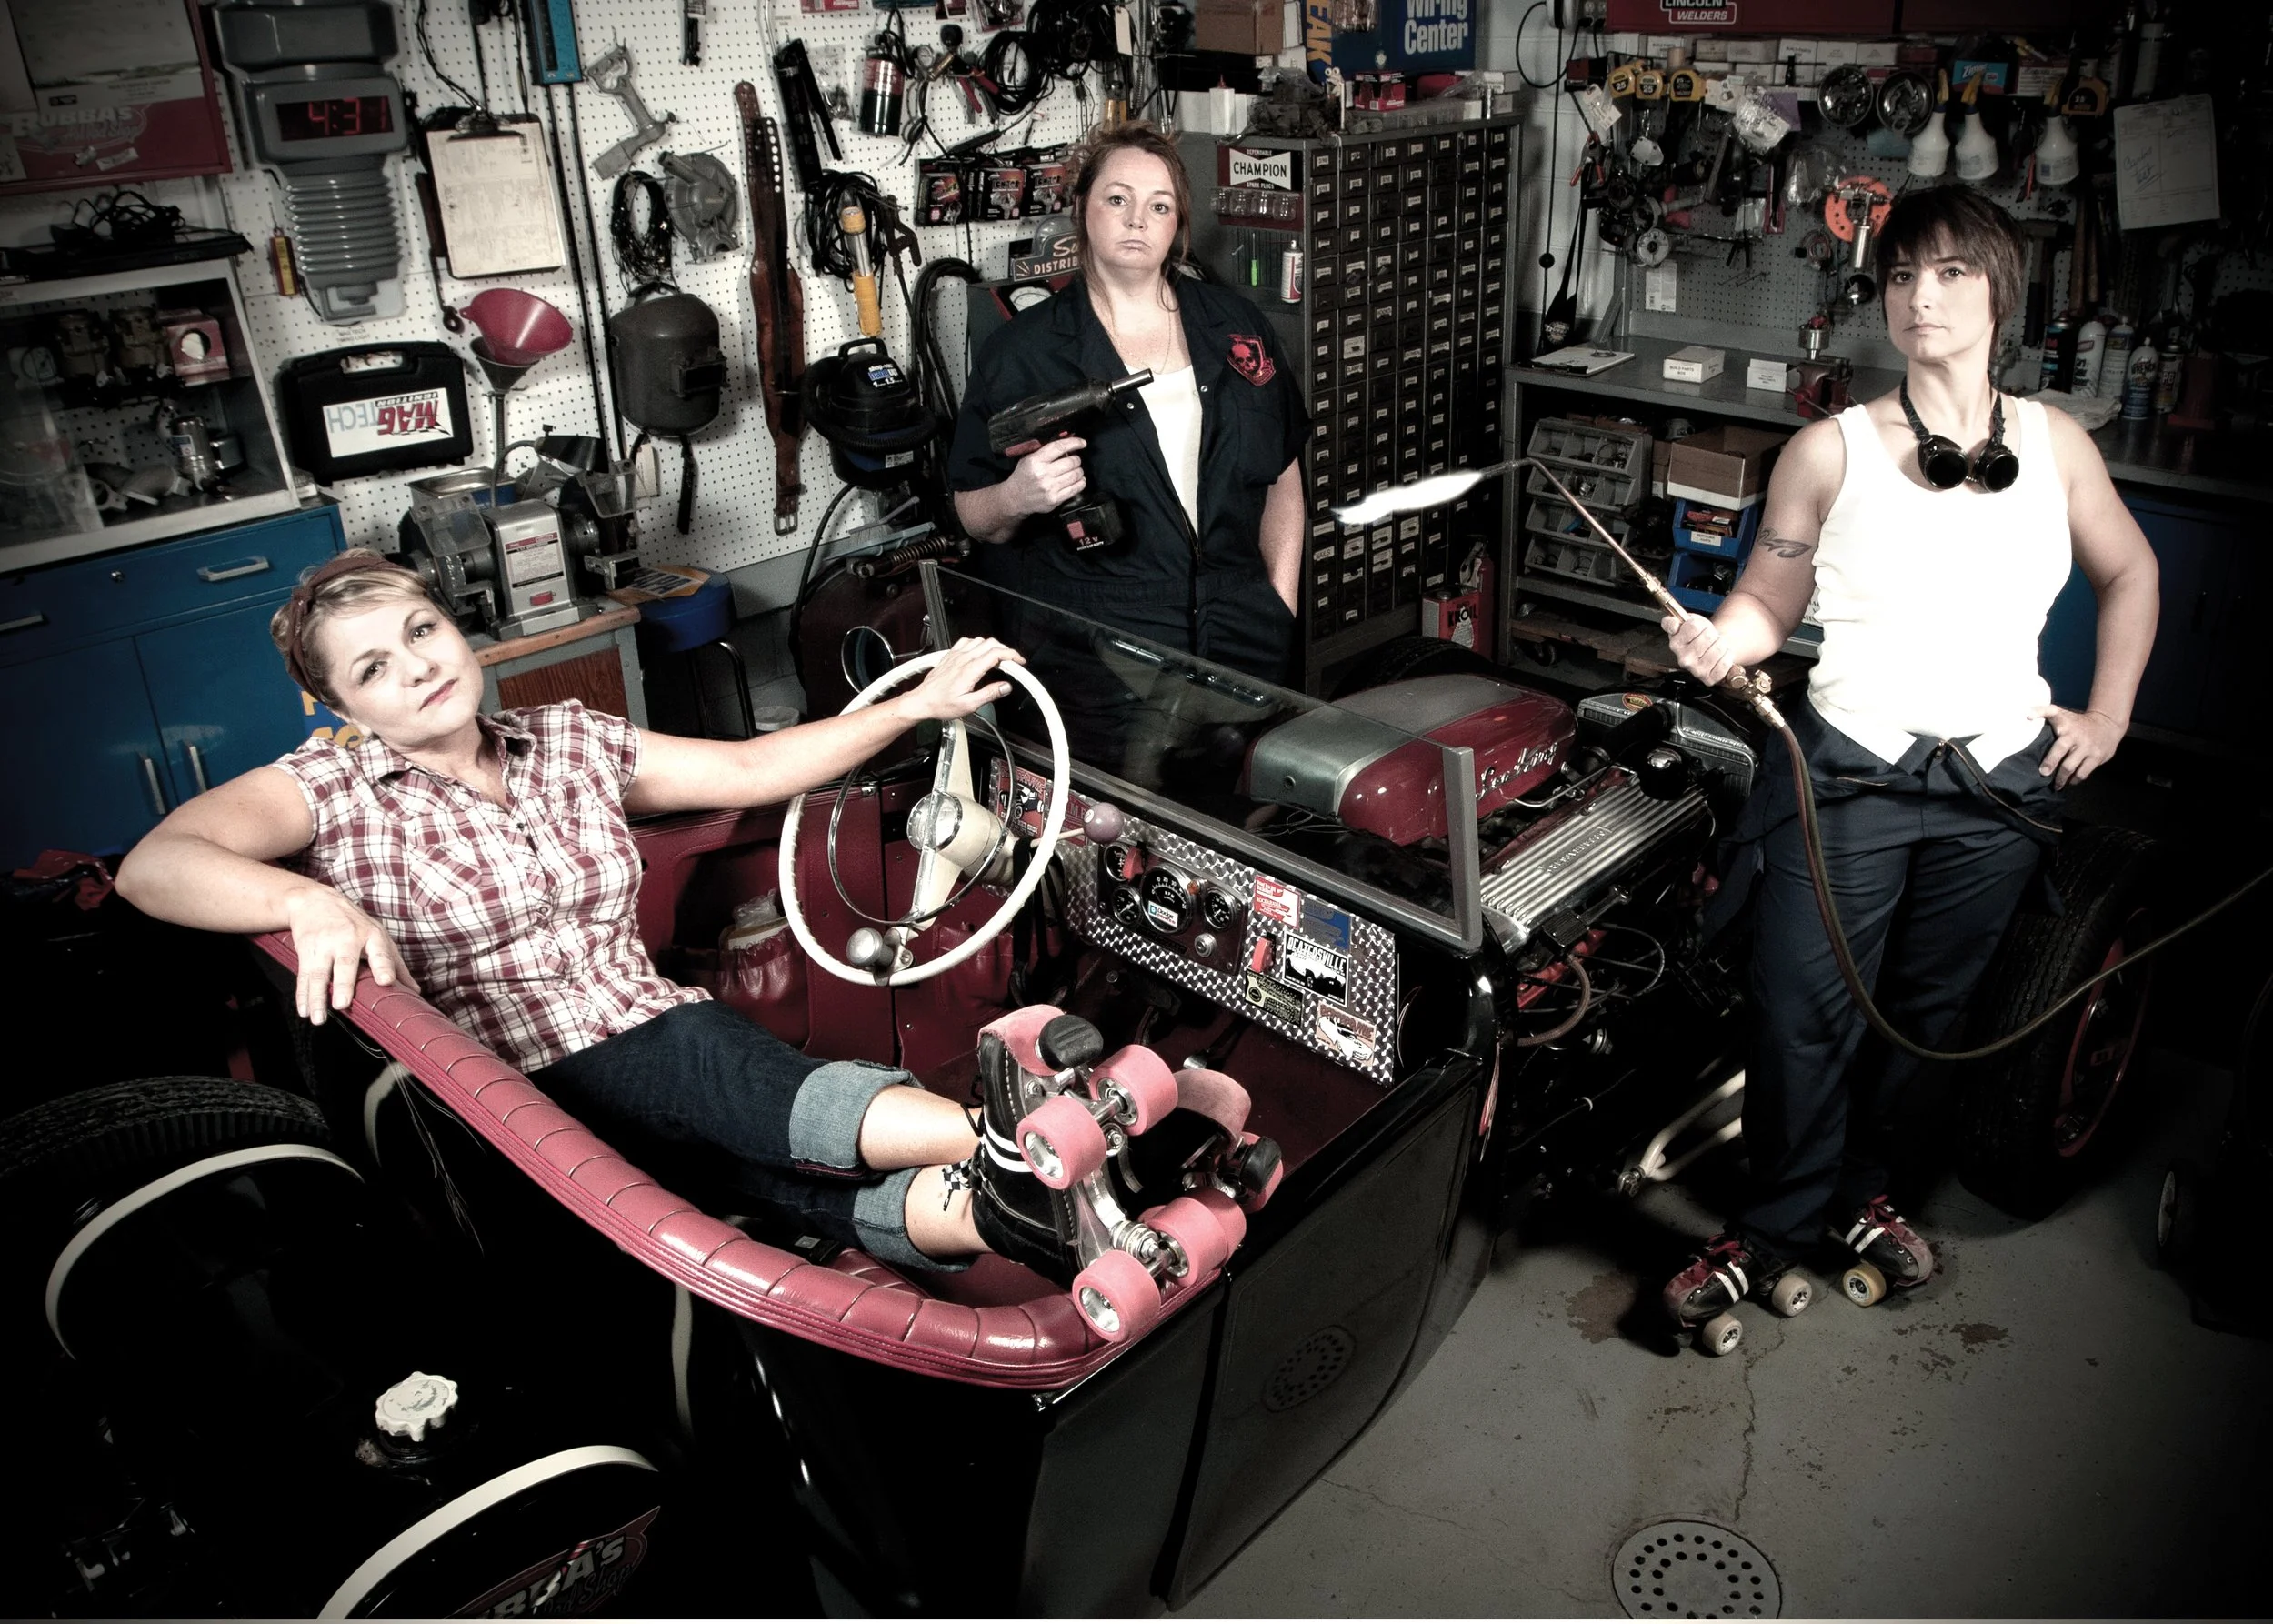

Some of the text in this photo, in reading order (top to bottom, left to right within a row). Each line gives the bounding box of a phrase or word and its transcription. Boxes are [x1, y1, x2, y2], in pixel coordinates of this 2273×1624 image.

[1677, 10, 1728, 21] WELDERS
[1404, 19, 1468, 55] Center
[1643, 85, 1654, 95] 25
[308, 95, 389, 136] 4:31
[1234, 162, 1287, 178] CHAMPION
[1053, 236, 1078, 257] Su
[1034, 256, 1079, 275] DISTRIB
[1447, 604, 1477, 627] KROIL
[476, 1535, 626, 1619] BBA'S
